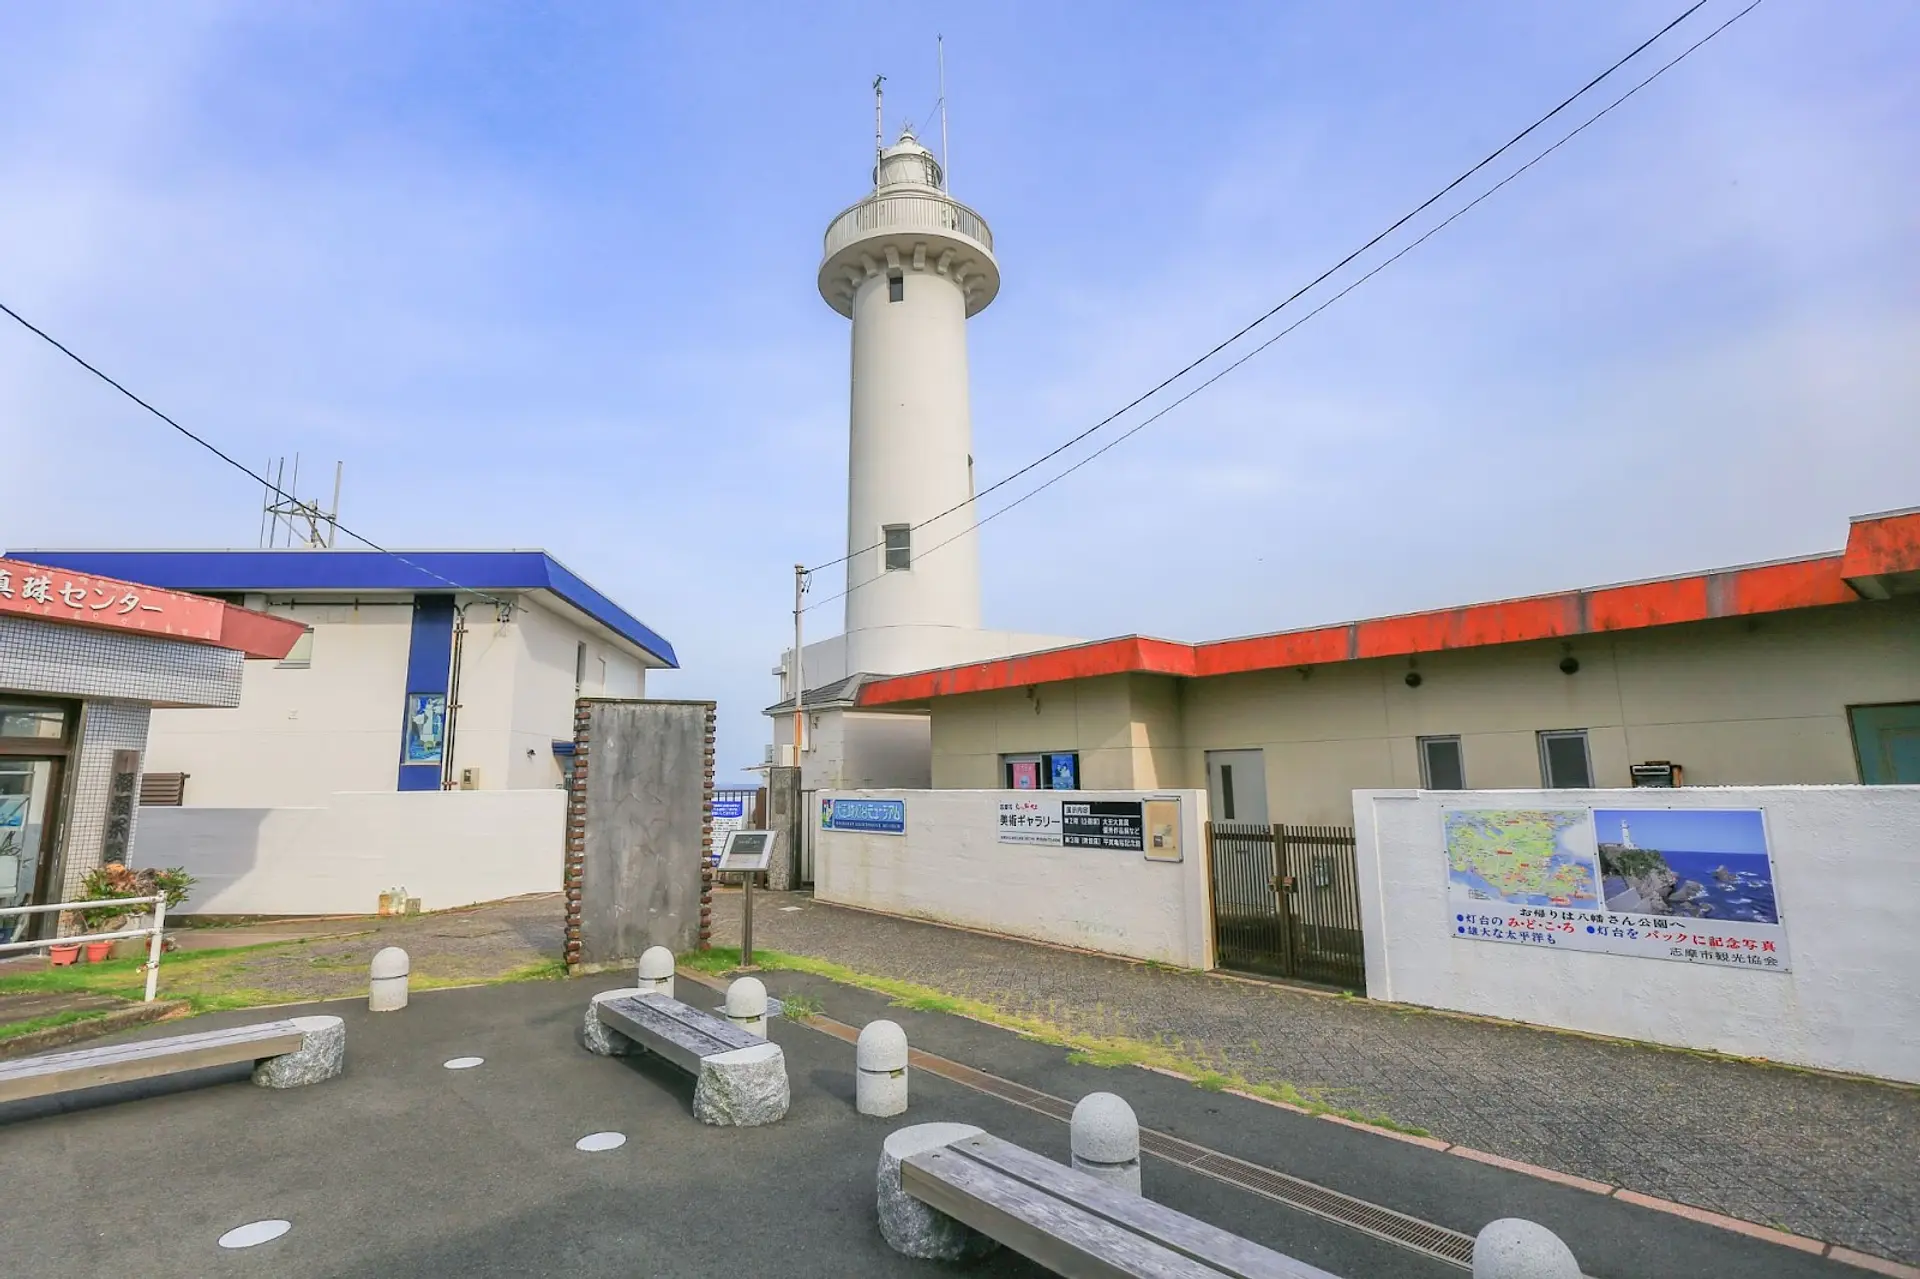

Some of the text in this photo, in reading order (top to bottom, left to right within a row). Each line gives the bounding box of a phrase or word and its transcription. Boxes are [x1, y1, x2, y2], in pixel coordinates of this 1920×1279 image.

[0, 568, 163, 615] 真珠センター
[1000, 814, 1060, 827] 美術ギャラリー
[1466, 913, 1503, 926] 灯台の
[1519, 908, 1686, 929] お帰りは八幡さん公園へ
[1467, 925, 1556, 944] 雄大な太平洋も
[1597, 925, 1777, 953] 灯台を バックに記念写真
[1670, 947, 1779, 966] 志摩市観光協会
